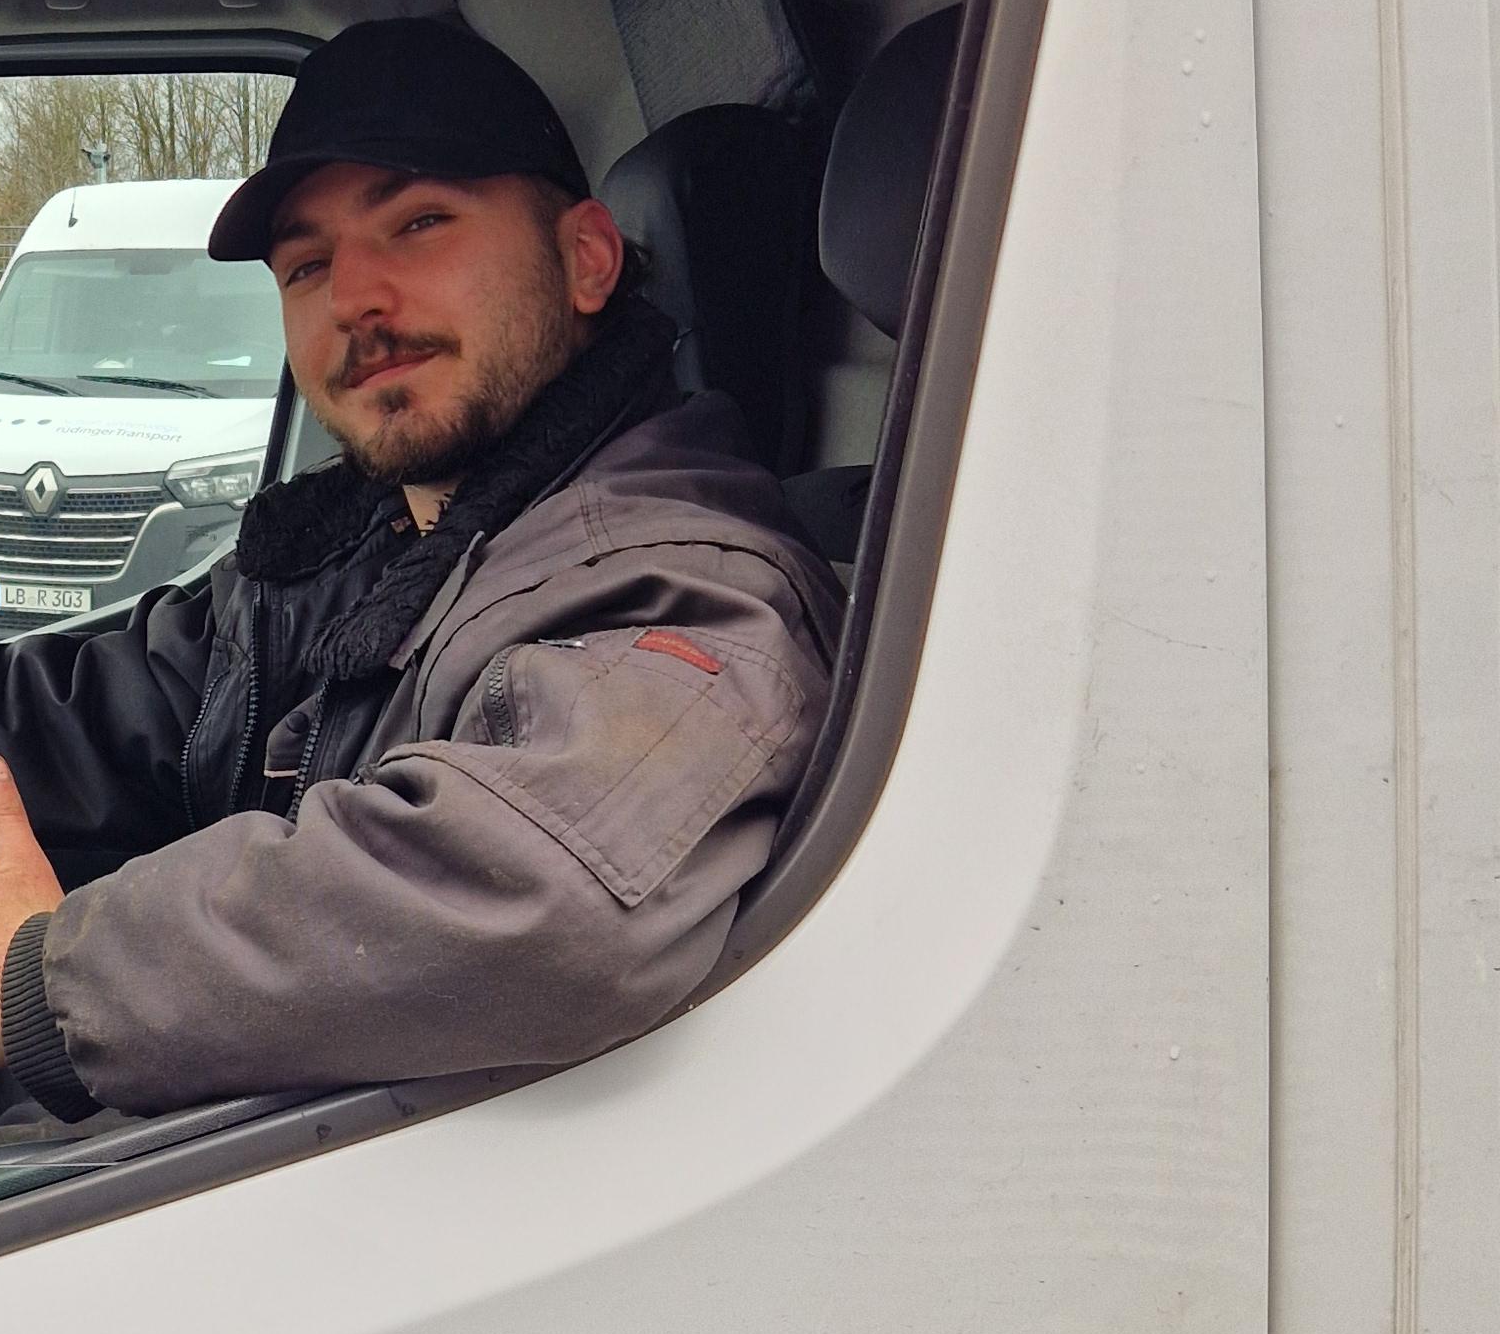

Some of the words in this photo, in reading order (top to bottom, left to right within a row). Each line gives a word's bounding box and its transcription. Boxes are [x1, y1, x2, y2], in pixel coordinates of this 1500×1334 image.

[5, 587, 26, 605] LB
[37, 589, 47, 606] R
[52, 590, 83, 608] 303
